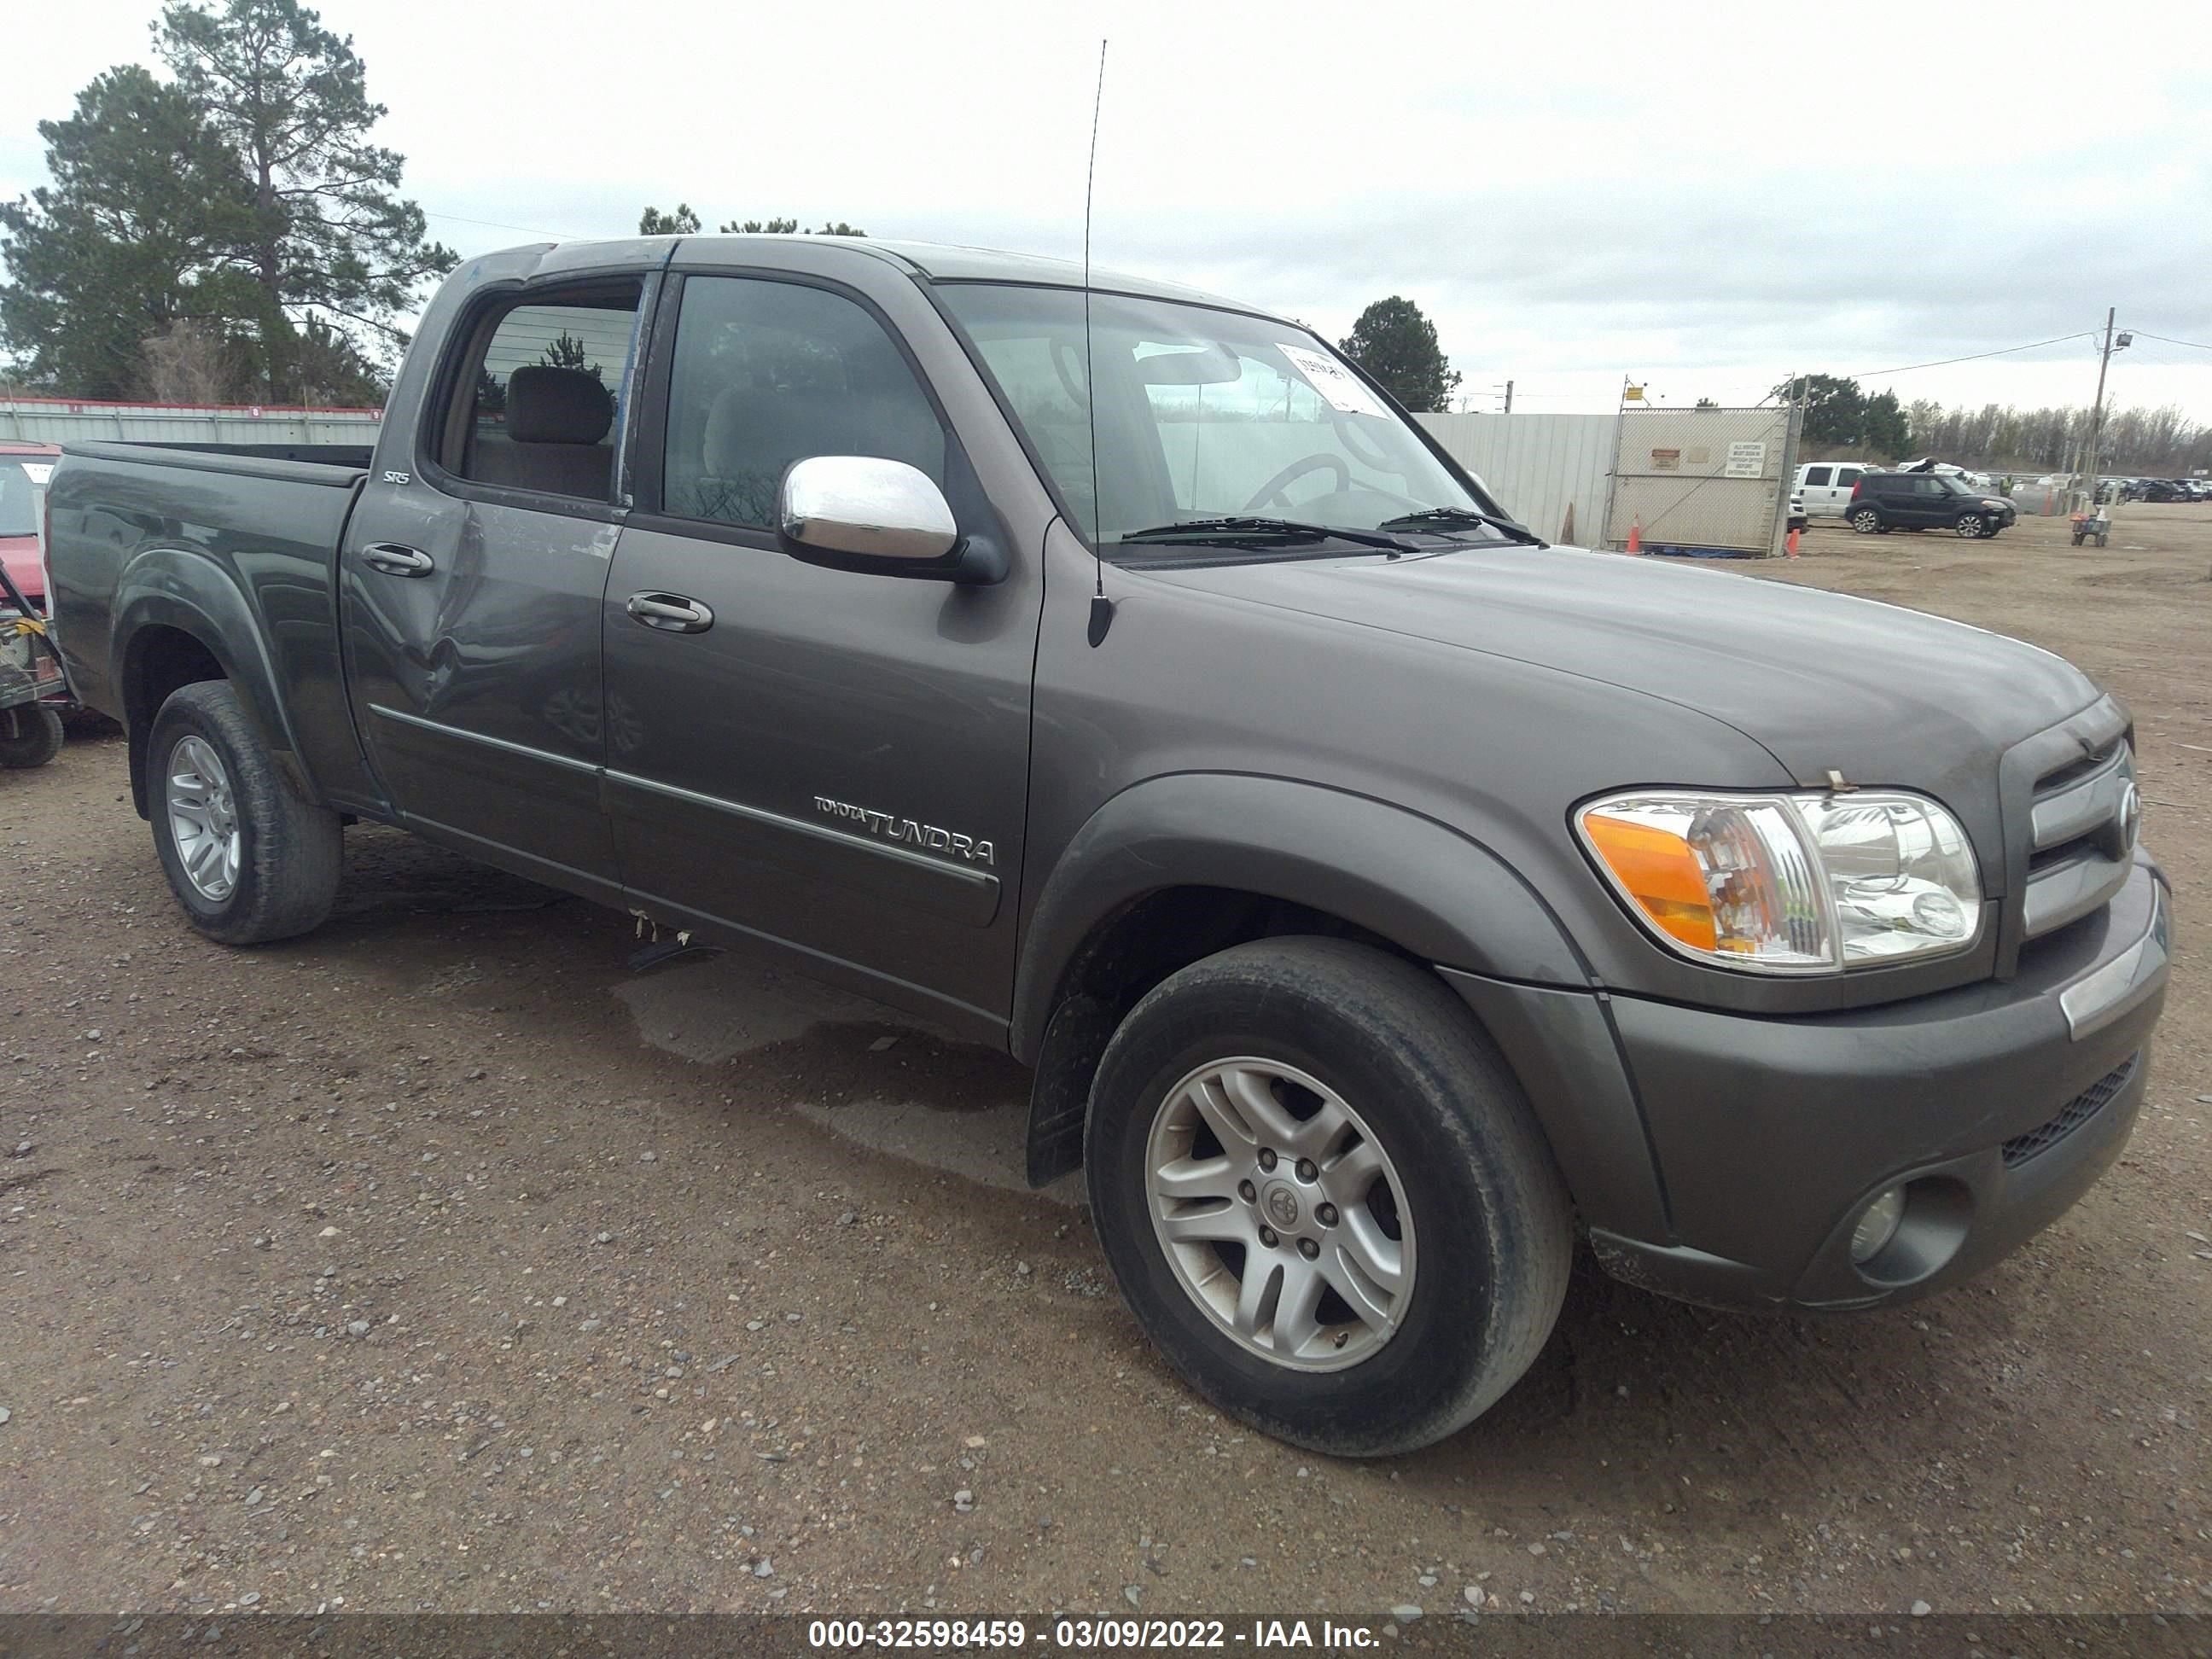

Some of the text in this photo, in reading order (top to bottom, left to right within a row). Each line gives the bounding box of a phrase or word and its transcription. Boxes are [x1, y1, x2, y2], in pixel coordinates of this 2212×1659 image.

[383, 470, 410, 485] SR5
[813, 795, 995, 866] TOYOTA TUNDRA
